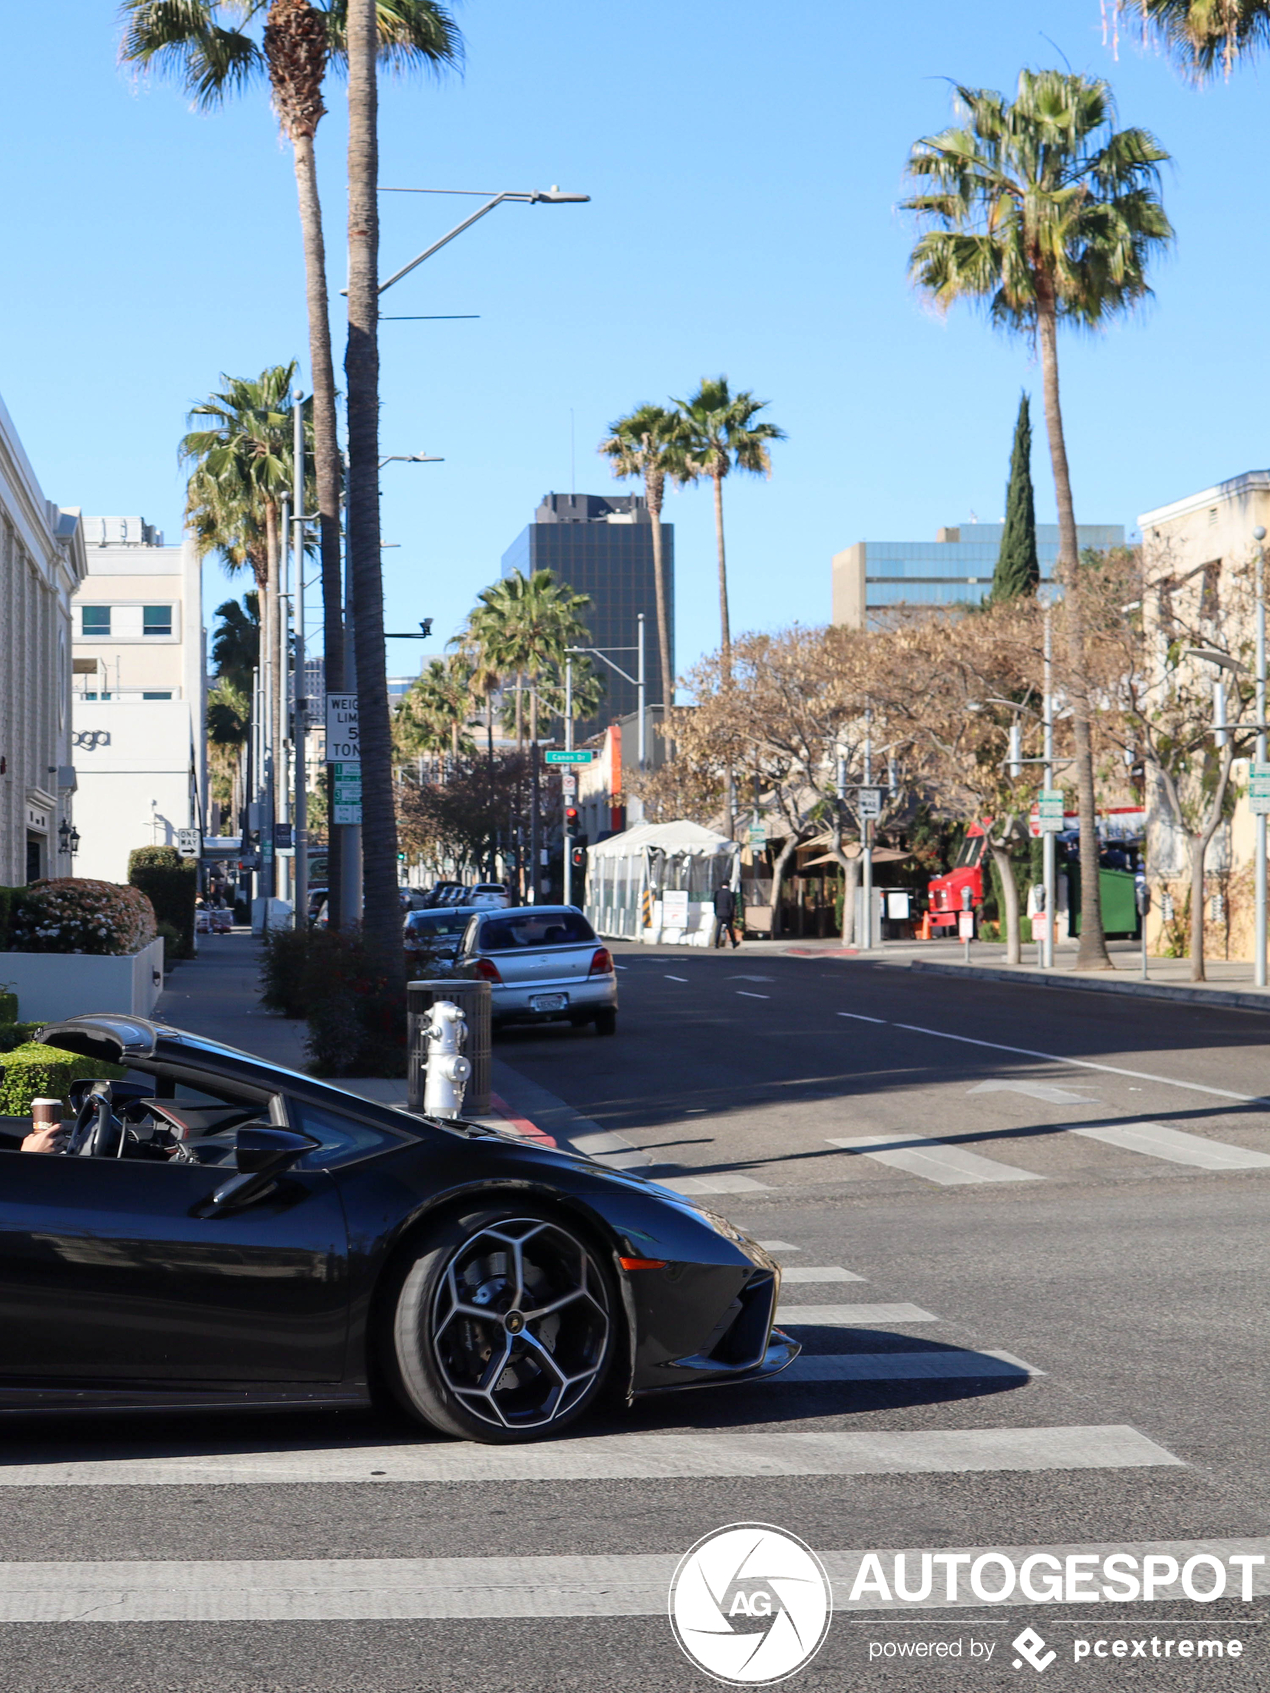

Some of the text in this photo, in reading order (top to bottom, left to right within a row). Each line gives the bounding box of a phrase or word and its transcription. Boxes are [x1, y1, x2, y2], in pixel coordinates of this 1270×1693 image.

[332, 699, 359, 710] WEIG
[337, 713, 358, 723] LIM
[348, 727, 359, 740] 5
[333, 743, 361, 757] TON
